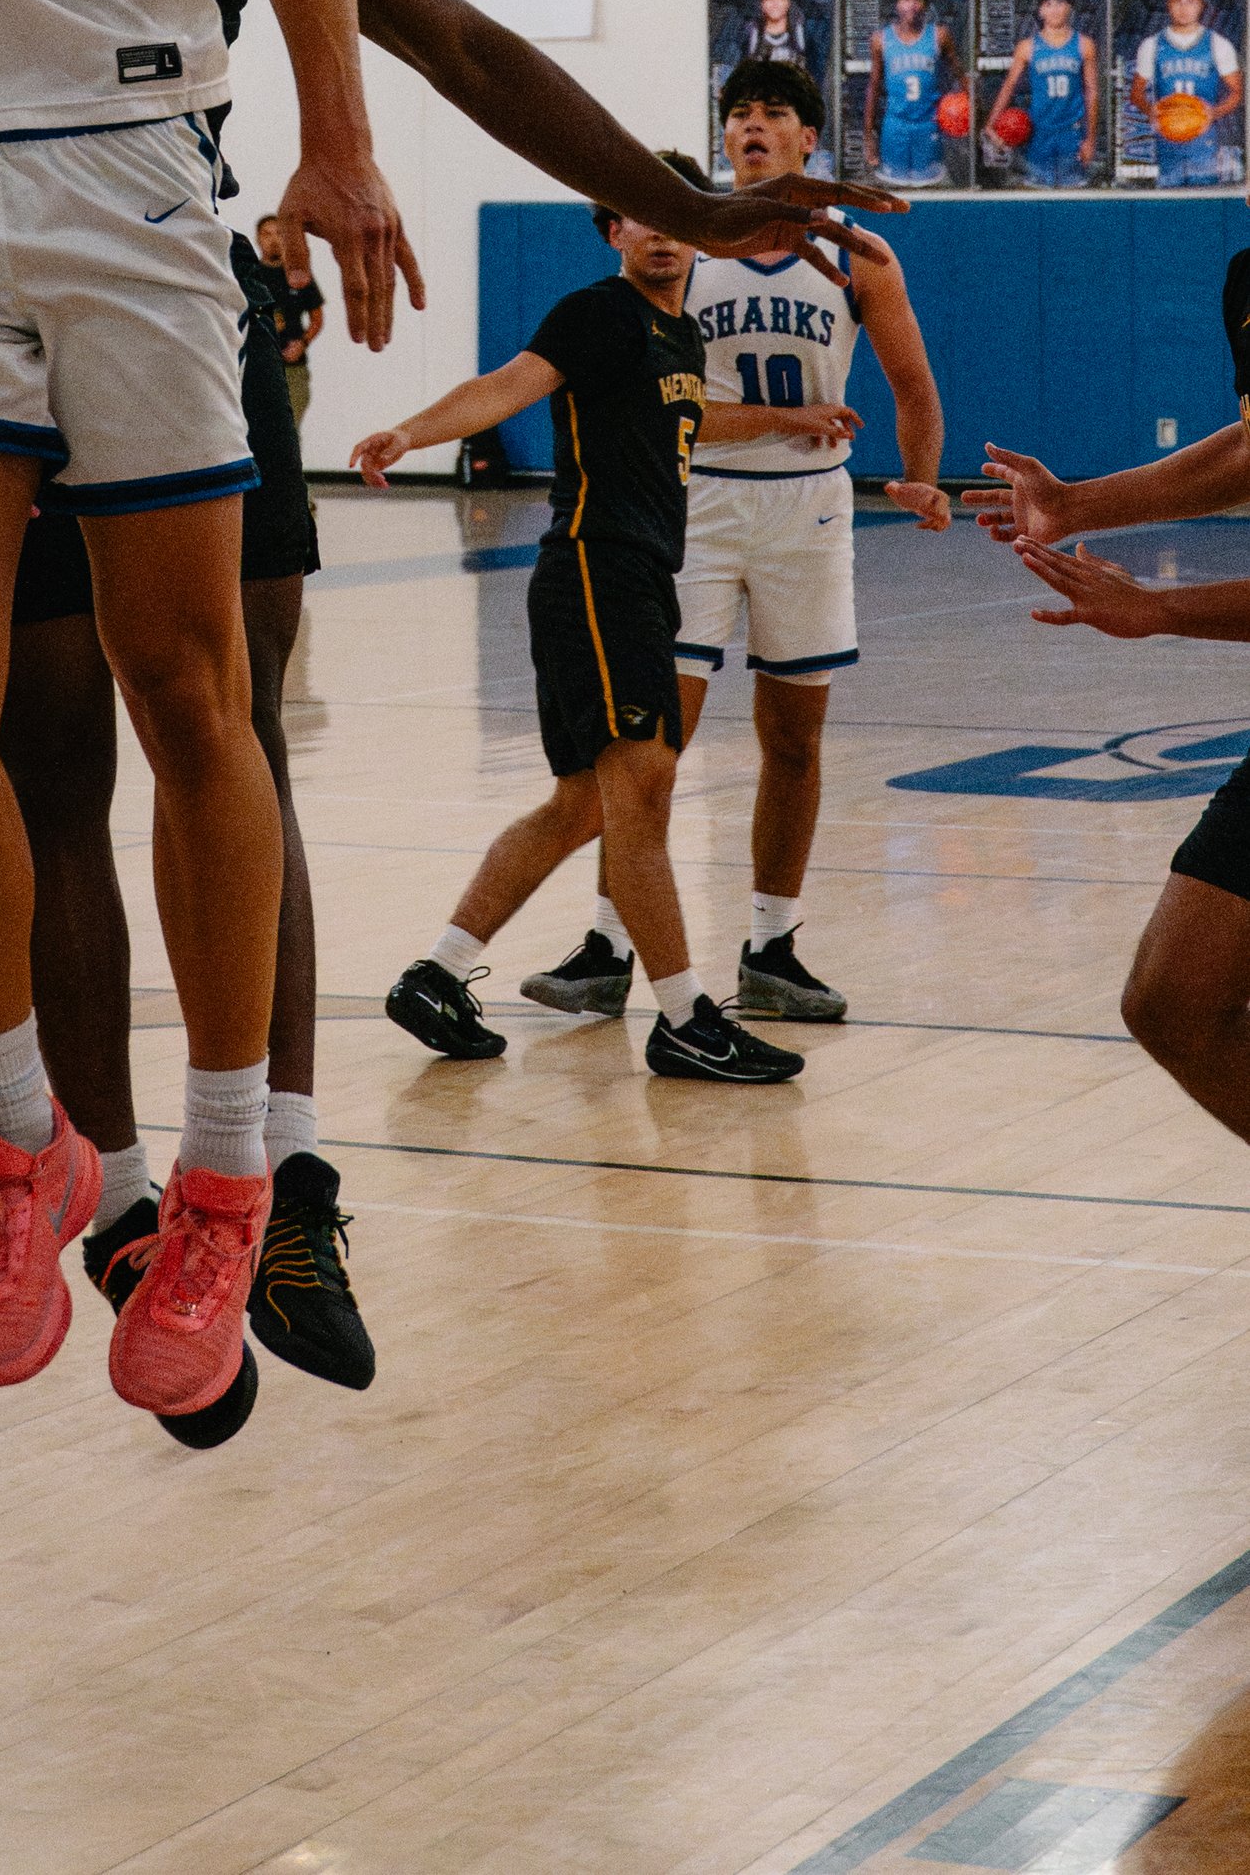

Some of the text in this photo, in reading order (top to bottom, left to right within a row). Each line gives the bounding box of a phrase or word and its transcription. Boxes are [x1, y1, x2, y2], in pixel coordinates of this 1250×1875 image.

[164, 53, 174, 68] L
[905, 75, 921, 102] 3
[698, 296, 835, 348] SHARKS
[735, 352, 803, 407] 10
[677, 416, 696, 487] 5
